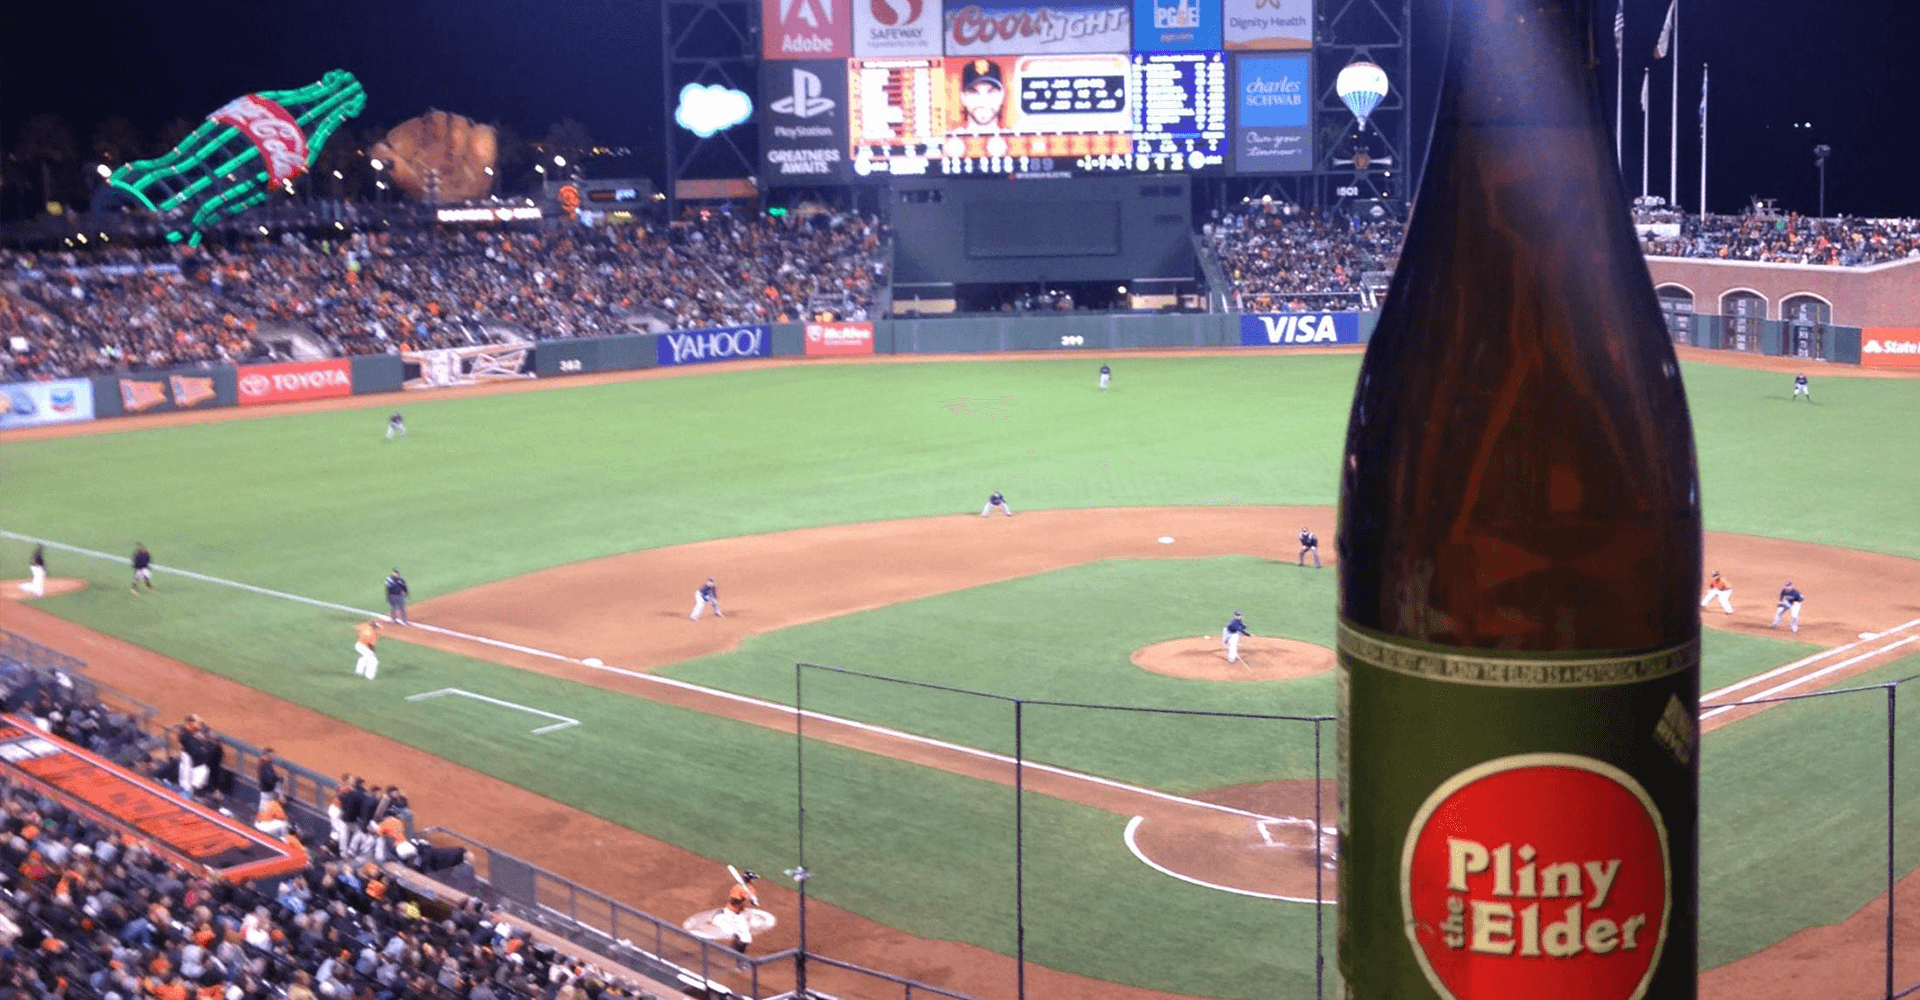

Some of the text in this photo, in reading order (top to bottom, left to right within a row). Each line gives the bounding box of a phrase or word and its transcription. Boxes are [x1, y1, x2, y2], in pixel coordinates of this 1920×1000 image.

[1230, 16, 1307, 30] Dignity Health
[782, 34, 834, 52] Adobe
[870, 28, 922, 39] SAFEWAY
[1246, 75, 1301, 93] charles
[767, 149, 841, 163] GREATNESS
[1258, 314, 1338, 343] VISA
[666, 328, 763, 363] YAHOO!
[1884, 339, 1917, 354] State
[272, 370, 349, 390] TOYOTA
[1446, 837, 1621, 909] Pliny
[1439, 896, 1464, 949] the
[1470, 900, 1646, 957] Elder
